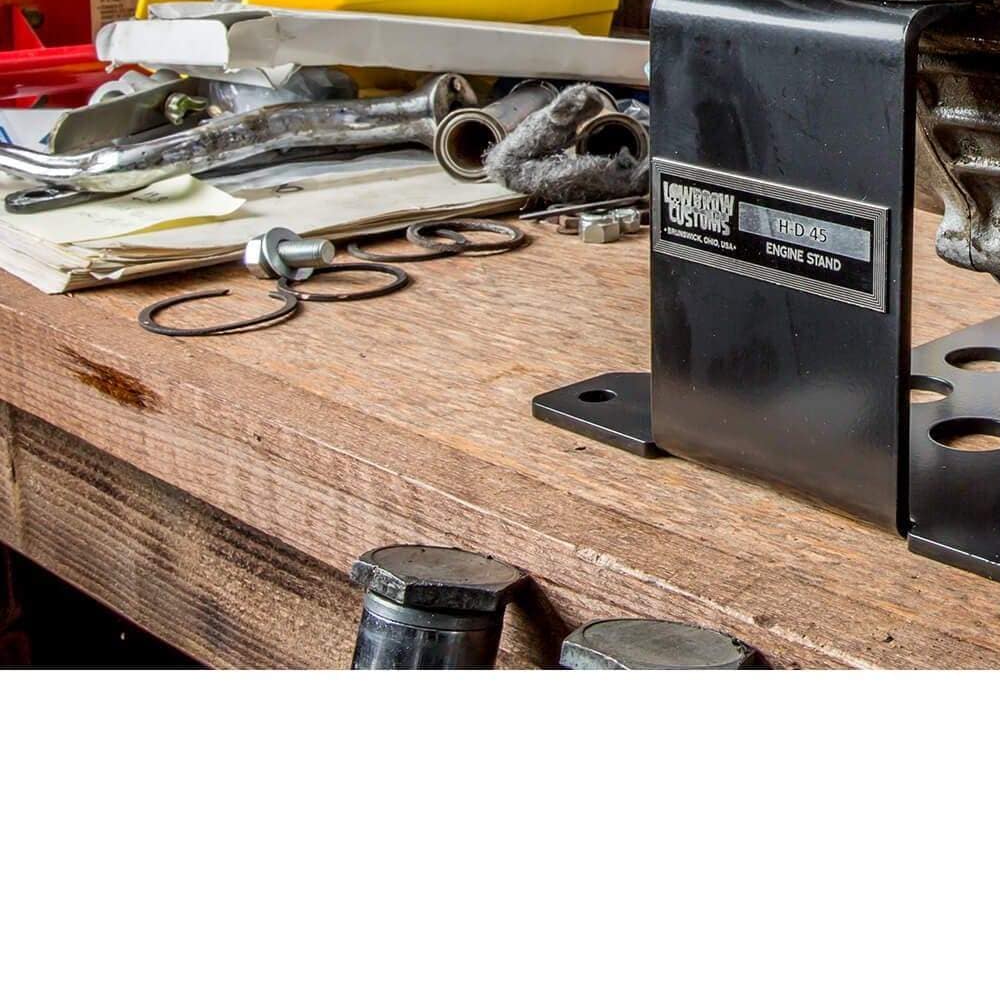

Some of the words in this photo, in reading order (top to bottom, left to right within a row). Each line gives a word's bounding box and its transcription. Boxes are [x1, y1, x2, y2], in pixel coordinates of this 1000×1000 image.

[663, 181, 735, 216] LOWBROW
[668, 202, 731, 236] CUSTOMS
[809, 227, 827, 243] 45
[766, 241, 805, 263] ENGINE
[806, 252, 842, 272] STAND
